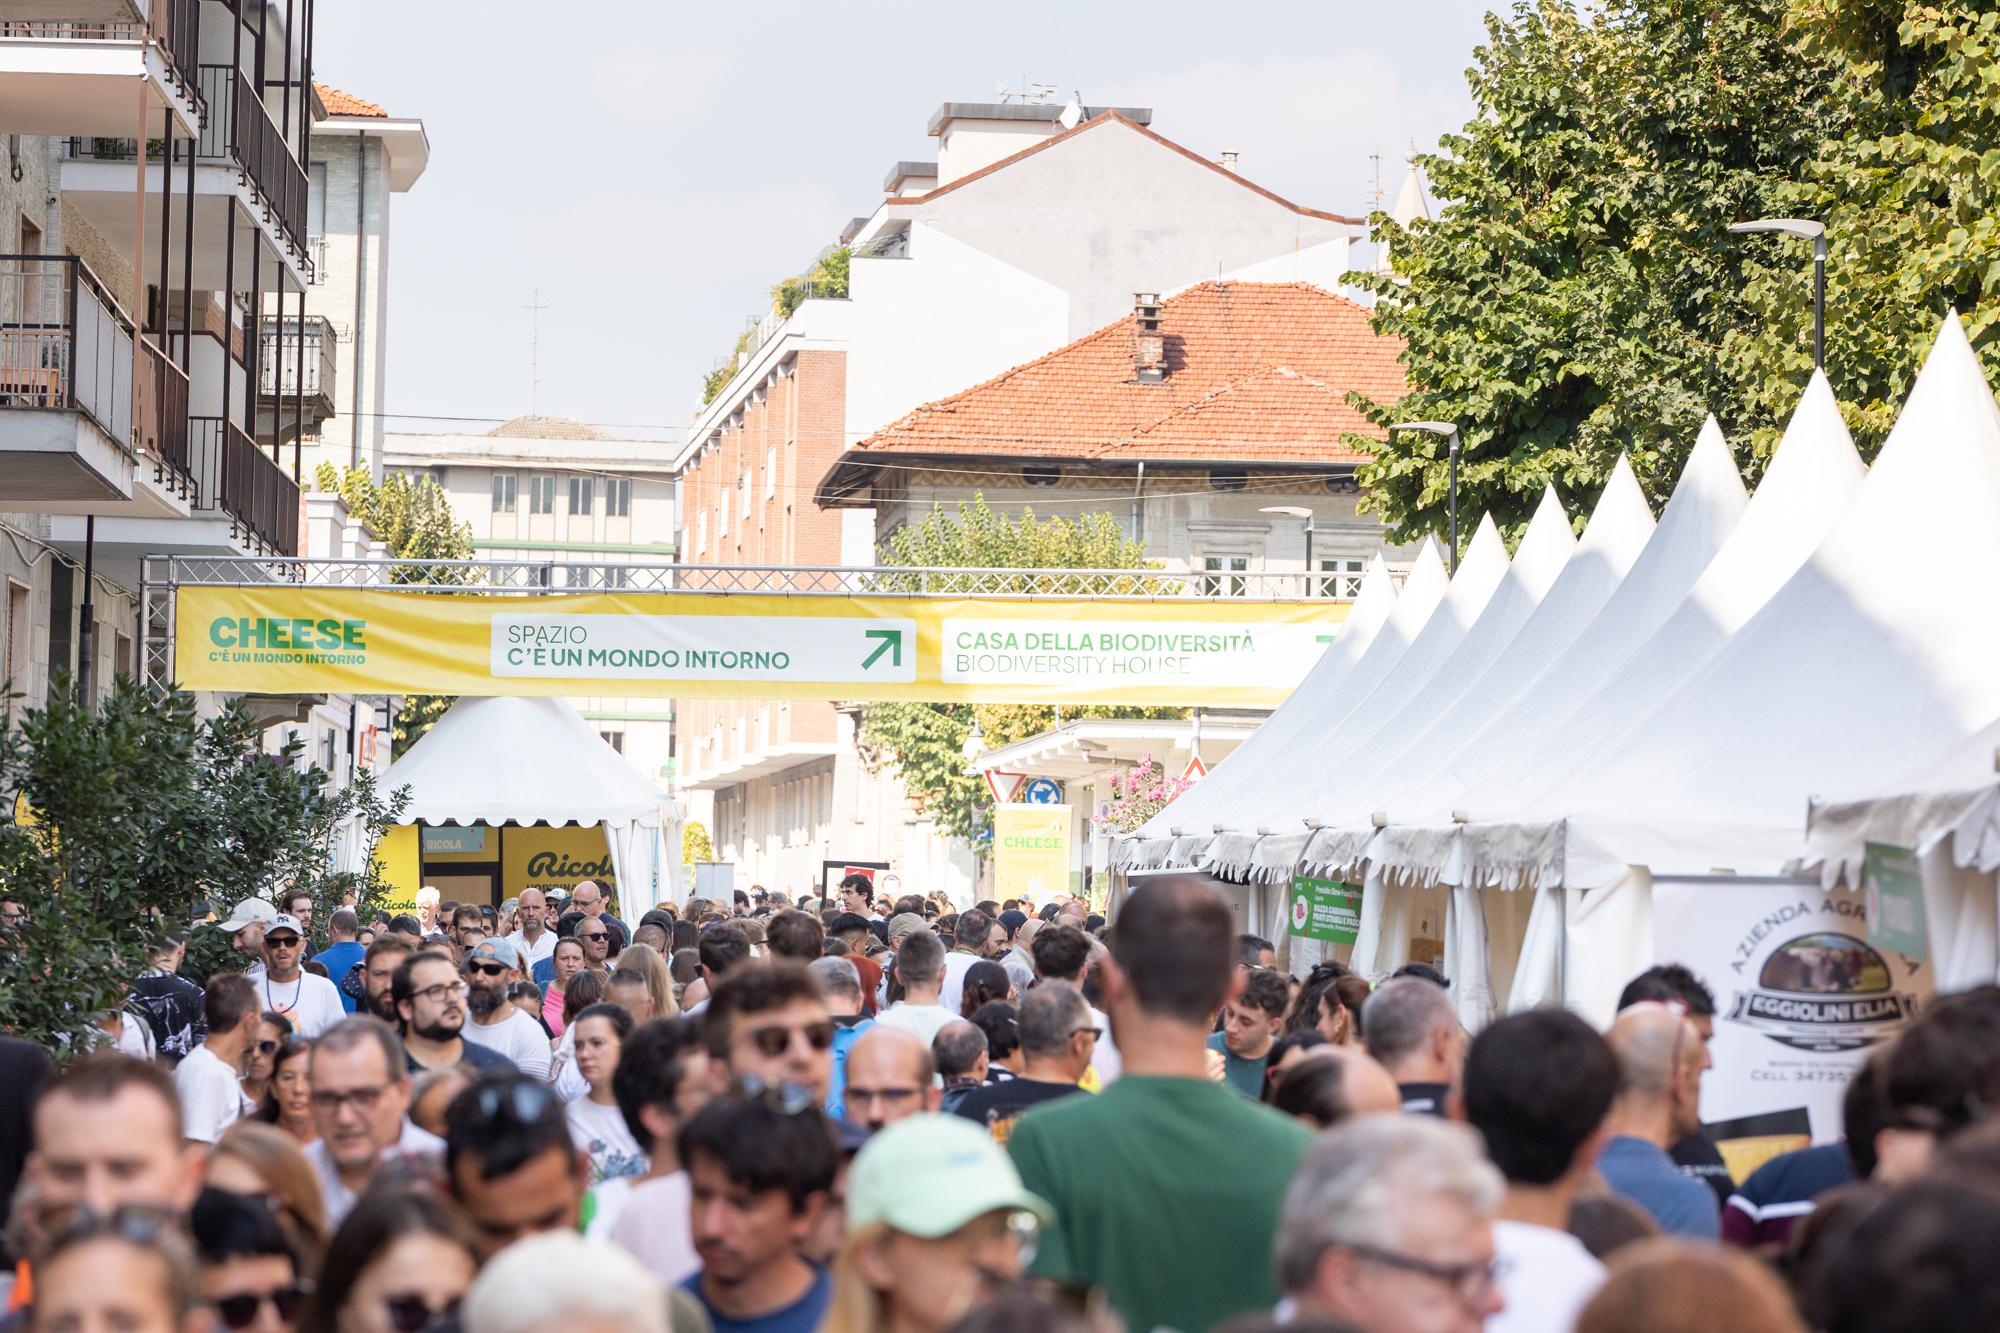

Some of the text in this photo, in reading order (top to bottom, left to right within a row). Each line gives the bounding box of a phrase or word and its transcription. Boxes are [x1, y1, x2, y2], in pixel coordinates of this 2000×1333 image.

[209, 617, 366, 650] CHEESE
[508, 625, 587, 644] SPAZIO
[956, 629, 1256, 653] CASA DELLA BIODIVERSITÀ
[232, 652, 251, 663] UN
[254, 653, 303, 664] MONDO
[306, 654, 366, 665] INTORNO
[551, 648, 582, 667] UN
[588, 649, 680, 668] MONDO
[685, 650, 790, 670] INTORNO
[956, 654, 1191, 675] BIODIVERSITY HOUSE
[426, 839, 462, 850] RICOLA
[1004, 837, 1062, 849] CHEESE
[1313, 913, 1326, 922] PRATI
[1314, 904, 1328, 913] RAZZA
[1730, 900, 1811, 976] AZIENDA
[1751, 996, 1898, 1023] EGGIOLINI ELIA
